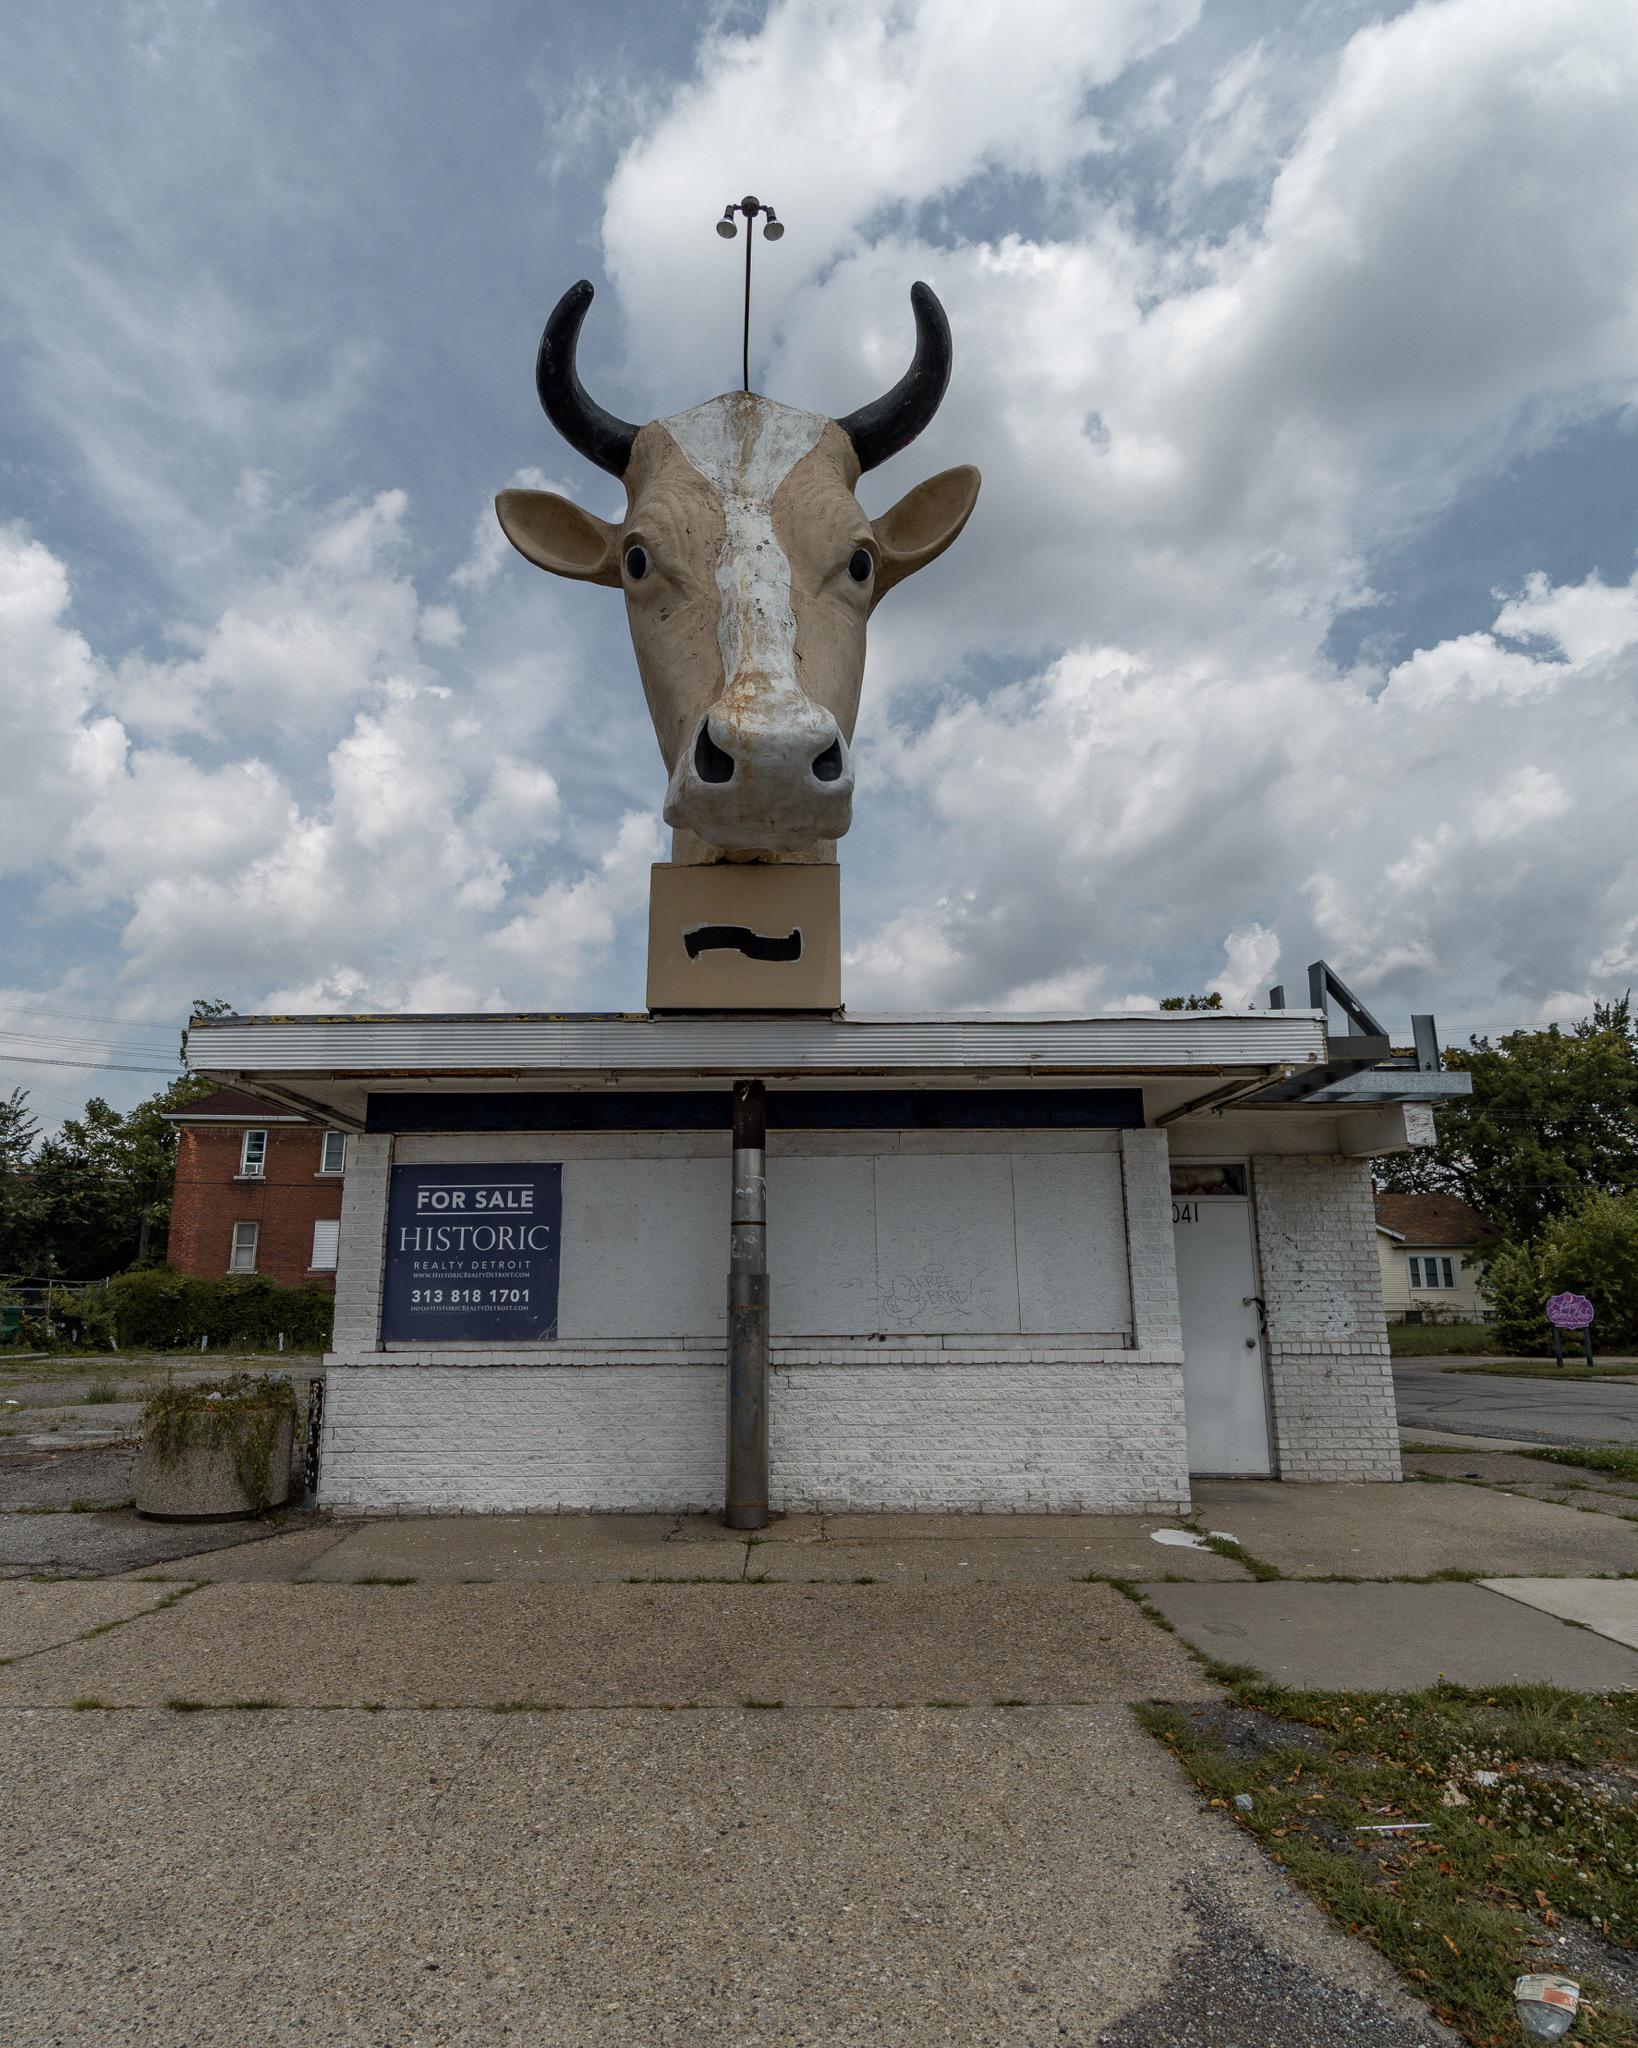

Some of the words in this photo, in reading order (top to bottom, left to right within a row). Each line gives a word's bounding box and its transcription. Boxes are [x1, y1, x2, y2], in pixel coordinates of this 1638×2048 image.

[417, 1191, 466, 1209] FOR
[475, 1190, 534, 1208] SALE
[400, 1225, 550, 1251] HISTORIC
[414, 1261, 464, 1270] REALTY
[472, 1260, 532, 1269] DETROIT
[411, 1289, 443, 1303] 313
[451, 1289, 481, 1303] 818
[489, 1289, 530, 1303] 1701
